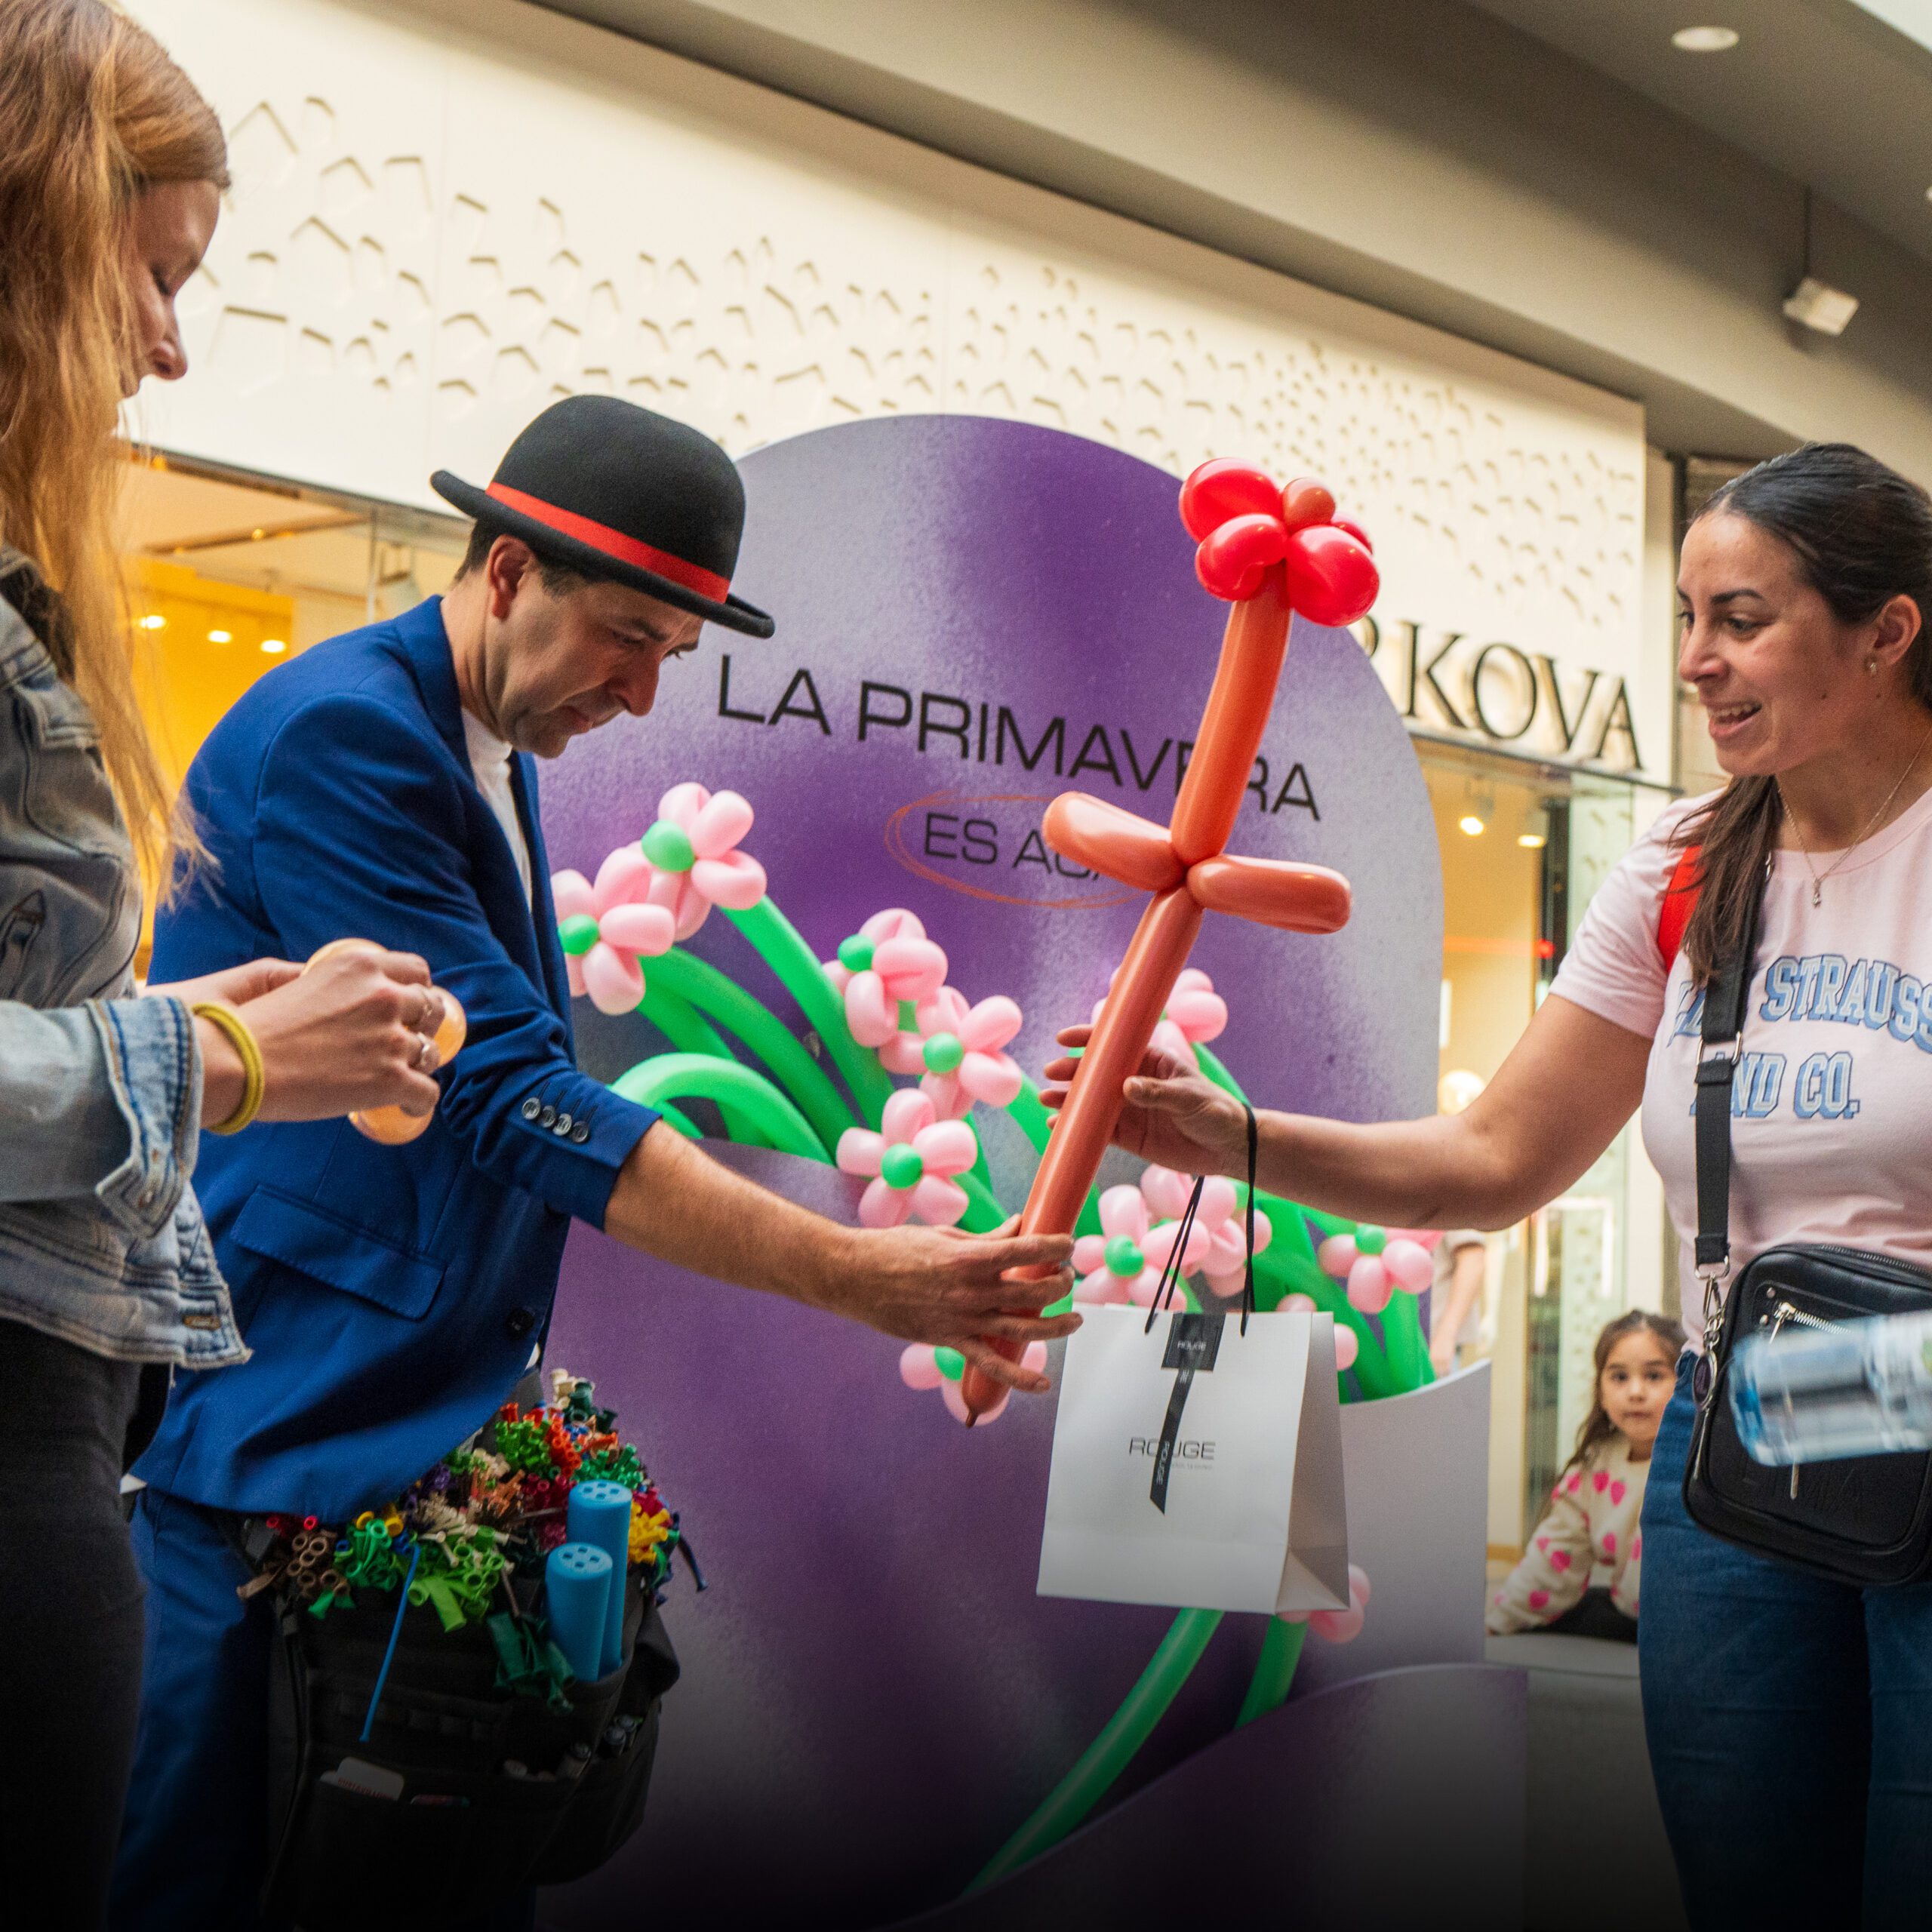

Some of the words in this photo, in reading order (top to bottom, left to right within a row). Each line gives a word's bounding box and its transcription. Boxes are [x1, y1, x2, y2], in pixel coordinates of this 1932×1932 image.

[718, 654, 832, 736] LA
[1358, 614, 1644, 771] KOVA
[924, 811, 999, 866] ES
[1690, 1051, 1787, 1118] ND
[1793, 1051, 1860, 1119] CO.
